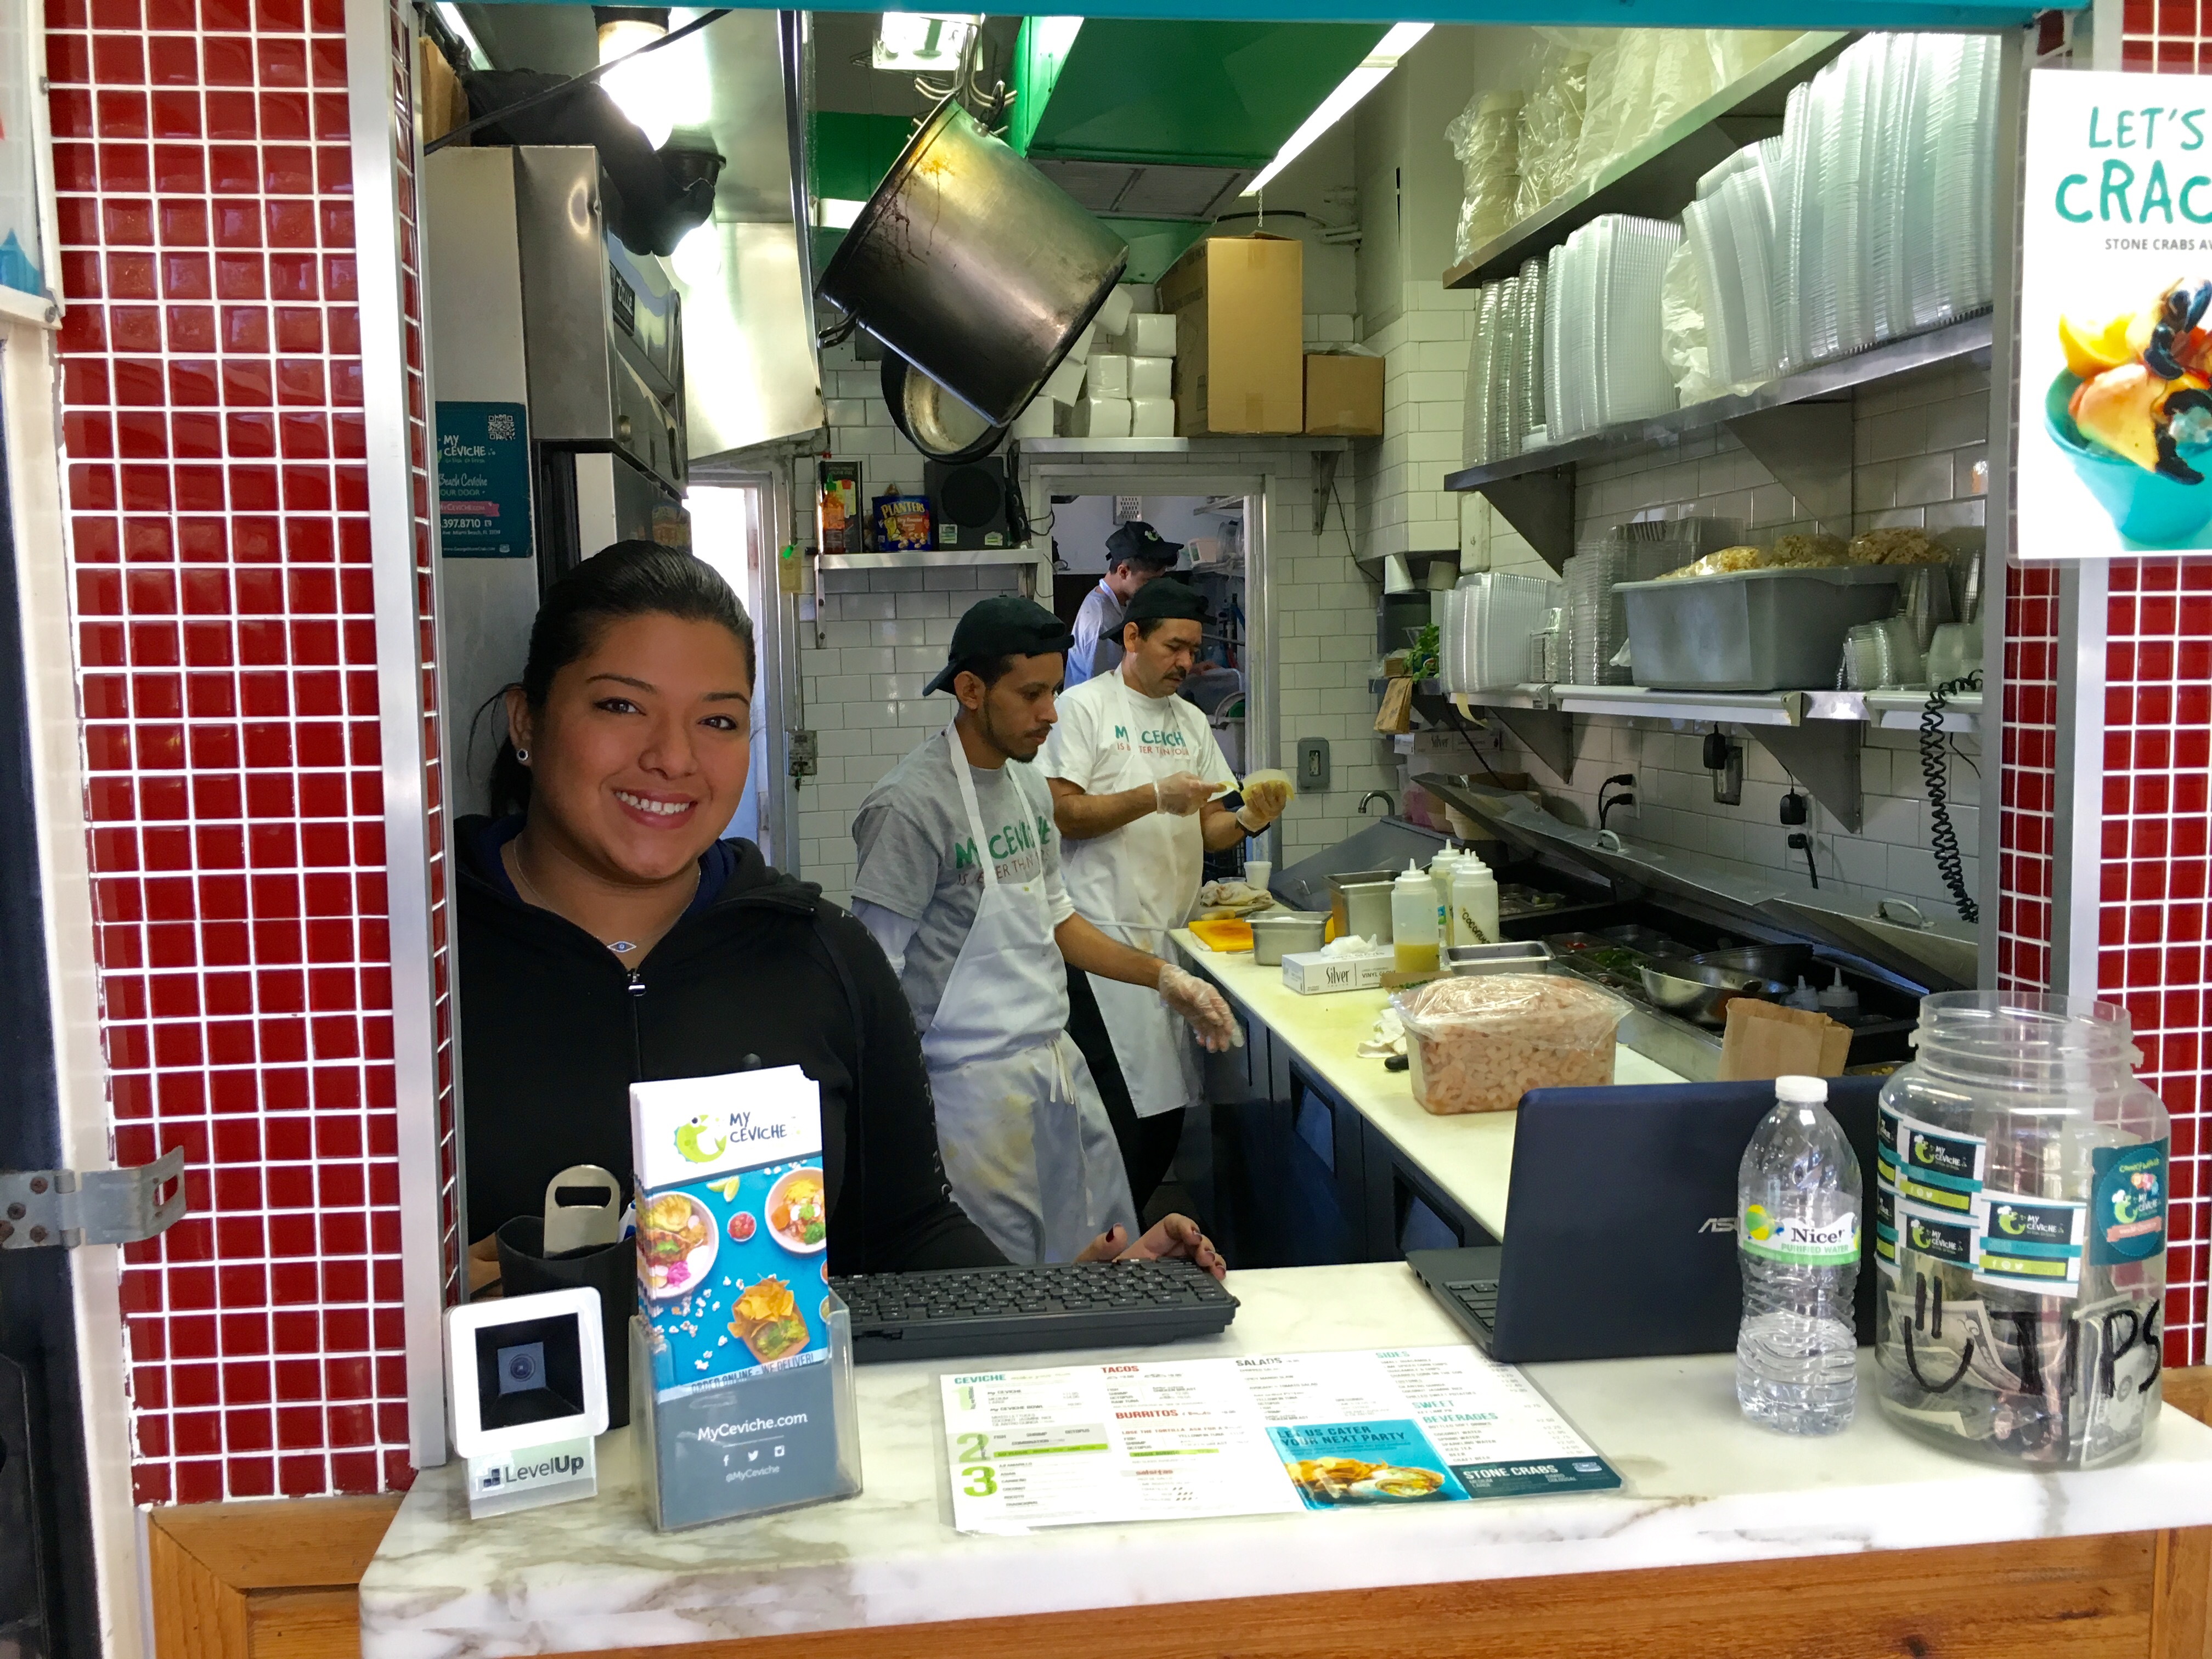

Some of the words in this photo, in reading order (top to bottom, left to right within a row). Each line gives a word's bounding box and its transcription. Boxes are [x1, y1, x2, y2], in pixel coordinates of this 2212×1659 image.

[2089, 106, 2205, 151] LET'S
[2055, 159, 2212, 224] CRAC
[2105, 239, 2148, 250] STONE
[2153, 239, 2195, 250] CRABS
[444, 435, 459, 447] MY
[444, 445, 486, 456] CEVICHE
[461, 473, 487, 486] Ceviche
[881, 501, 926, 518] PLANTERS
[1326, 966, 1350, 985] Silver
[729, 1111, 751, 1127] MY
[730, 1124, 787, 1143] CEVICHE
[1935, 1146, 1945, 1155] MY
[1935, 1154, 1961, 1167] CEVICHE
[2027, 1214, 2040, 1224] MY
[1932, 1230, 1942, 1239] MY
[2027, 1223, 2057, 1233] CEVICHE
[1791, 1227, 1843, 1244] Nice!
[1781, 1243, 1821, 1254] PURIFIED
[1824, 1244, 1849, 1253] WATER
[1932, 1239, 1957, 1250] CEVICHE
[1989, 1298, 2162, 1398] TIPS
[1235, 1357, 1283, 1367] SALADS
[691, 1378, 720, 1394] ORDER
[722, 1369, 753, 1386] ONLINE
[761, 1362, 777, 1375] WE
[777, 1353, 814, 1371] DELIVER!
[954, 1374, 1006, 1384] CEVICHE
[1412, 1400, 1454, 1409] SWEET
[1115, 1409, 1179, 1419] BURRITOS
[1422, 1413, 1498, 1423] BEVERAGES
[697, 1412, 808, 1442] MyCeviche.com
[1277, 1430, 1300, 1438] LET
[1305, 1427, 1323, 1436] US
[1328, 1426, 1371, 1436] CATER
[1281, 1437, 1318, 1446] YOUR
[1322, 1435, 1357, 1444] NEXT
[1361, 1432, 1405, 1441] PARTY
[957, 1433, 991, 1463] 2
[505, 1454, 585, 1483] LevelUp
[725, 1465, 780, 1482] @MyCeviche
[1463, 1468, 1510, 1480] STONE
[1510, 1465, 1558, 1476] CRABS
[961, 1466, 998, 1497] 3
